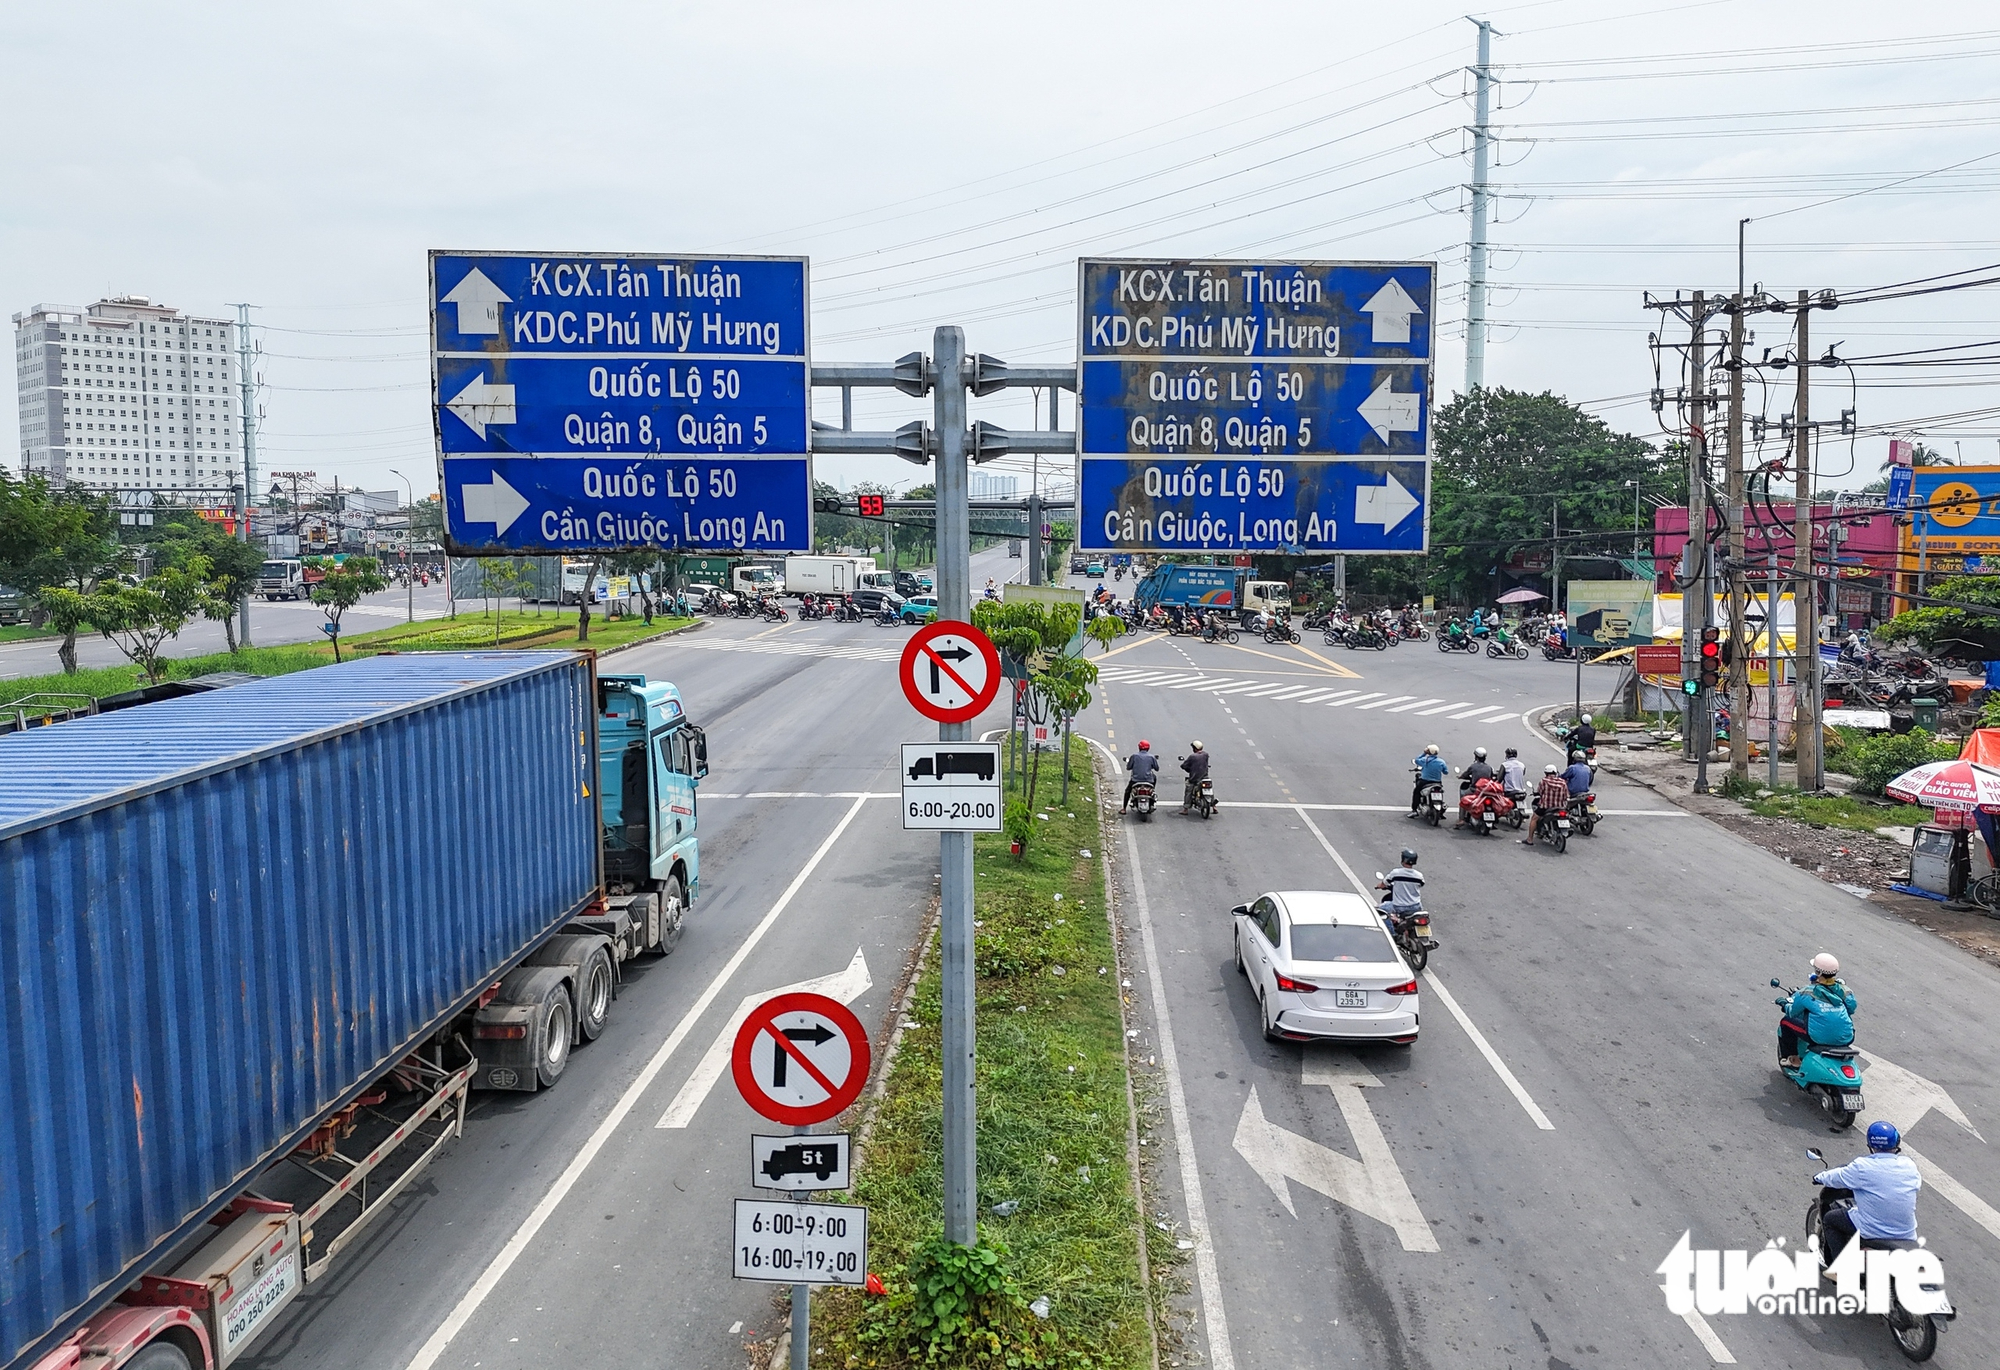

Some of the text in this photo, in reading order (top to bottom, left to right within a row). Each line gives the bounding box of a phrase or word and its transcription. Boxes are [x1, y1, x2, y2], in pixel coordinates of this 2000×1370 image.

[530, 262, 741, 305] KCX.Tân Thuận
[1119, 269, 1321, 310] KCX.Tân Thuận
[514, 310, 780, 355] KDC.Phú Mỹ Hưng
[1091, 312, 1340, 358] KDC.Phú Mỹ Hưng
[589, 362, 740, 404] Quốc Lộ 50
[1149, 366, 1303, 408] Quốc Lộ 50
[564, 411, 767, 452] Quận 8, Quận 5
[1130, 415, 1311, 453] Quận 8, Quận 5
[583, 463, 737, 504] Quốc Lộ 50
[1144, 464, 1284, 503] Quốc Lộ 50
[861, 496, 882, 515] 53
[541, 506, 590, 542] Cần
[684, 511, 746, 549] Long
[752, 511, 785, 542] An
[1104, 506, 1338, 548] Cần Giuộc, Long An
[909, 802, 995, 818] 6:00-20:00
[1924, 785, 1978, 799] GIÁO VIÊN
[1340, 998, 1364, 1006] 239.75
[802, 1150, 823, 1165] 5t
[752, 1213, 846, 1237] 6:00-9:00
[741, 1246, 857, 1272] 16:00-19:00
[227, 1255, 293, 1325] HOANG LONG AUTO
[228, 1279, 285, 1343] 090 250 2228
